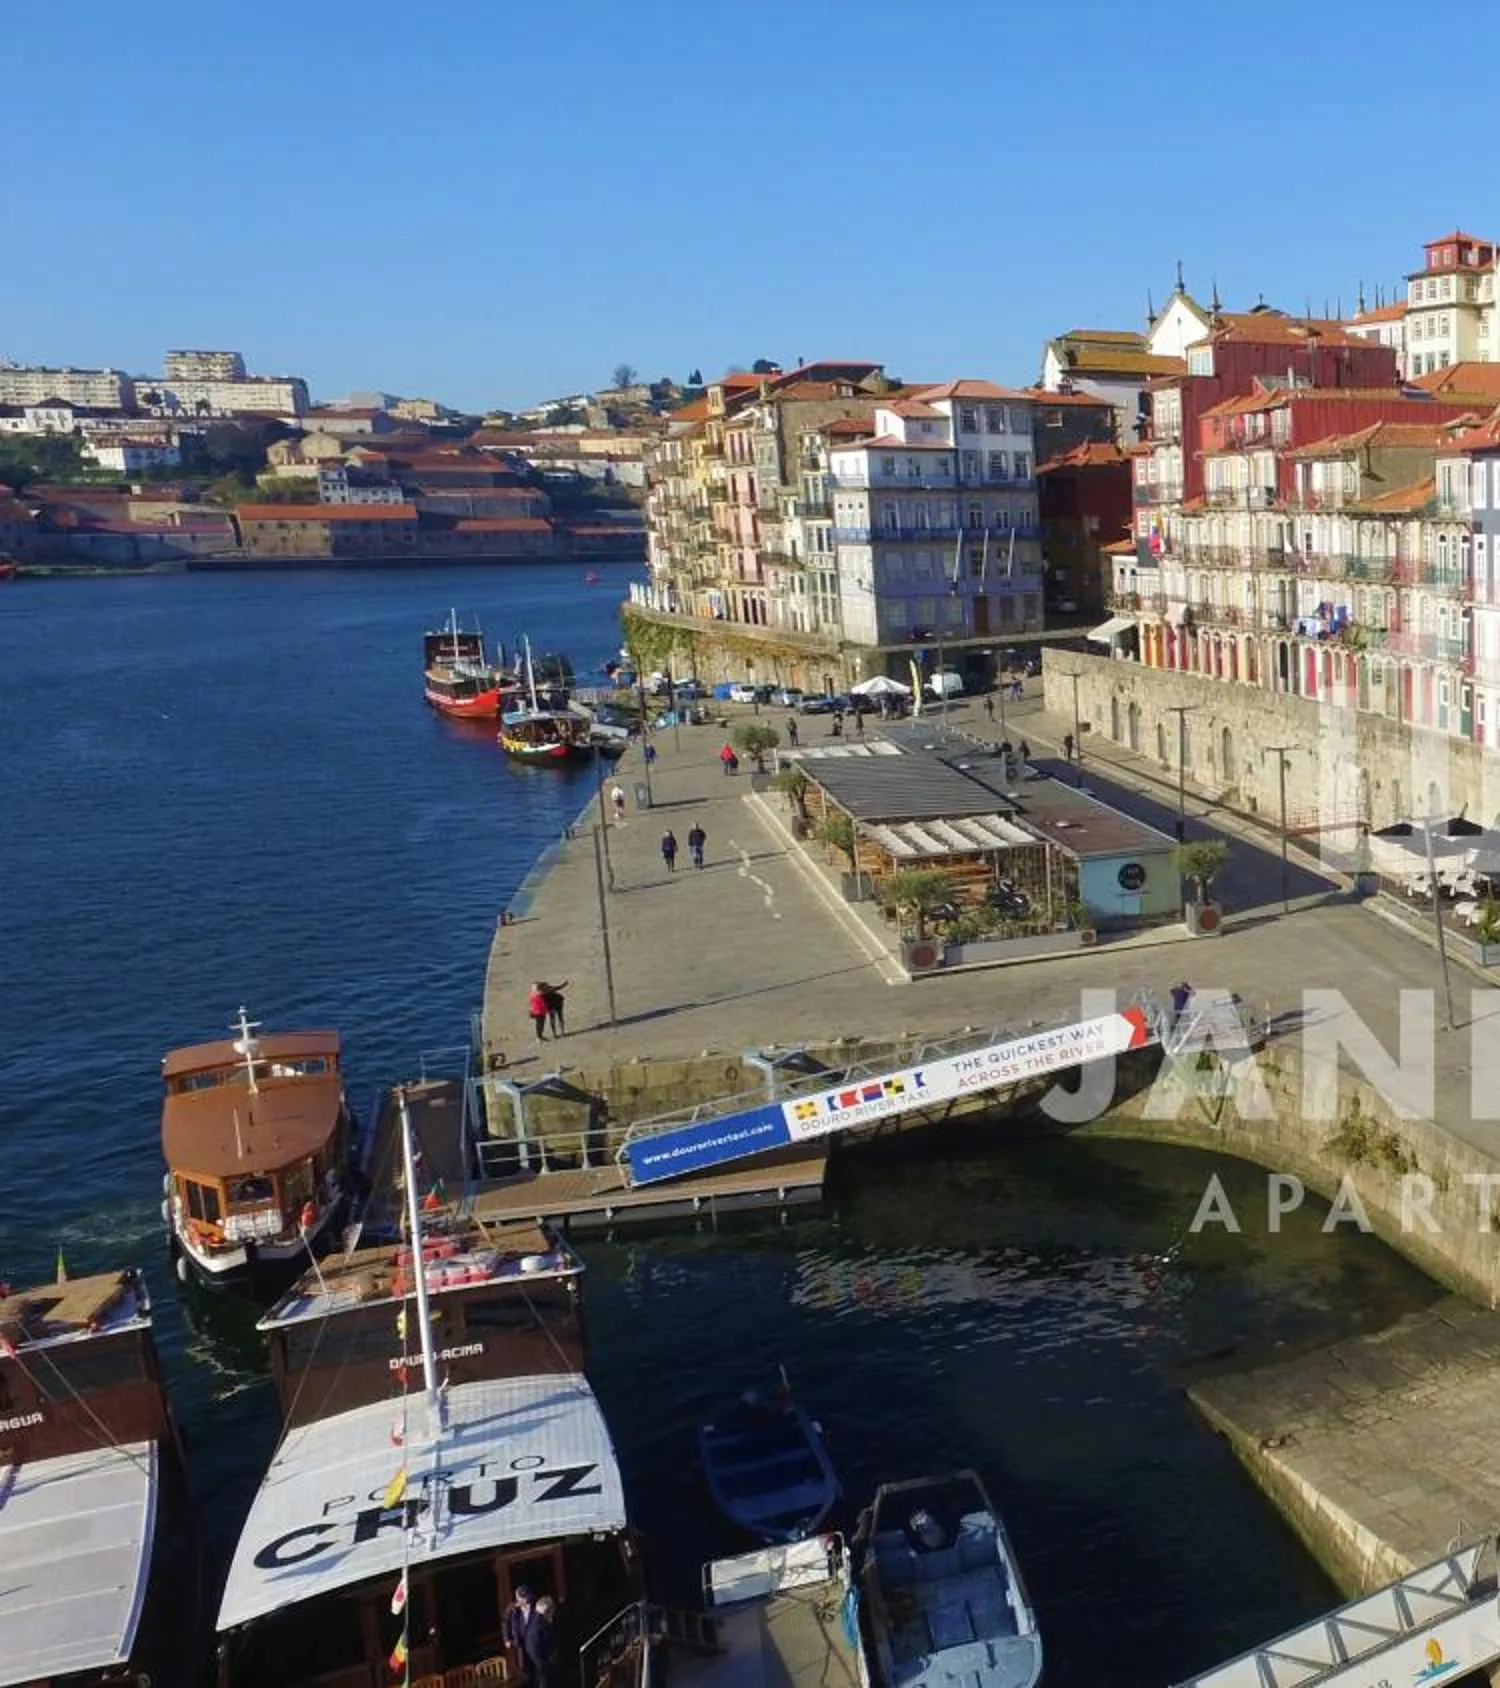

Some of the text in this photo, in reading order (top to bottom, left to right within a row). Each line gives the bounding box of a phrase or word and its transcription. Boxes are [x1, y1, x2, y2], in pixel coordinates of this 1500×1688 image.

[952, 1023, 1104, 1072] THE QUICKEST WAY
[957, 1063, 1020, 1088] ACROSS
[1025, 1053, 1053, 1070] THE
[800, 1111, 850, 1132] DOURO
[855, 1098, 897, 1116] RIVER
[642, 1122, 774, 1165] www.dourorivertaxi.com
